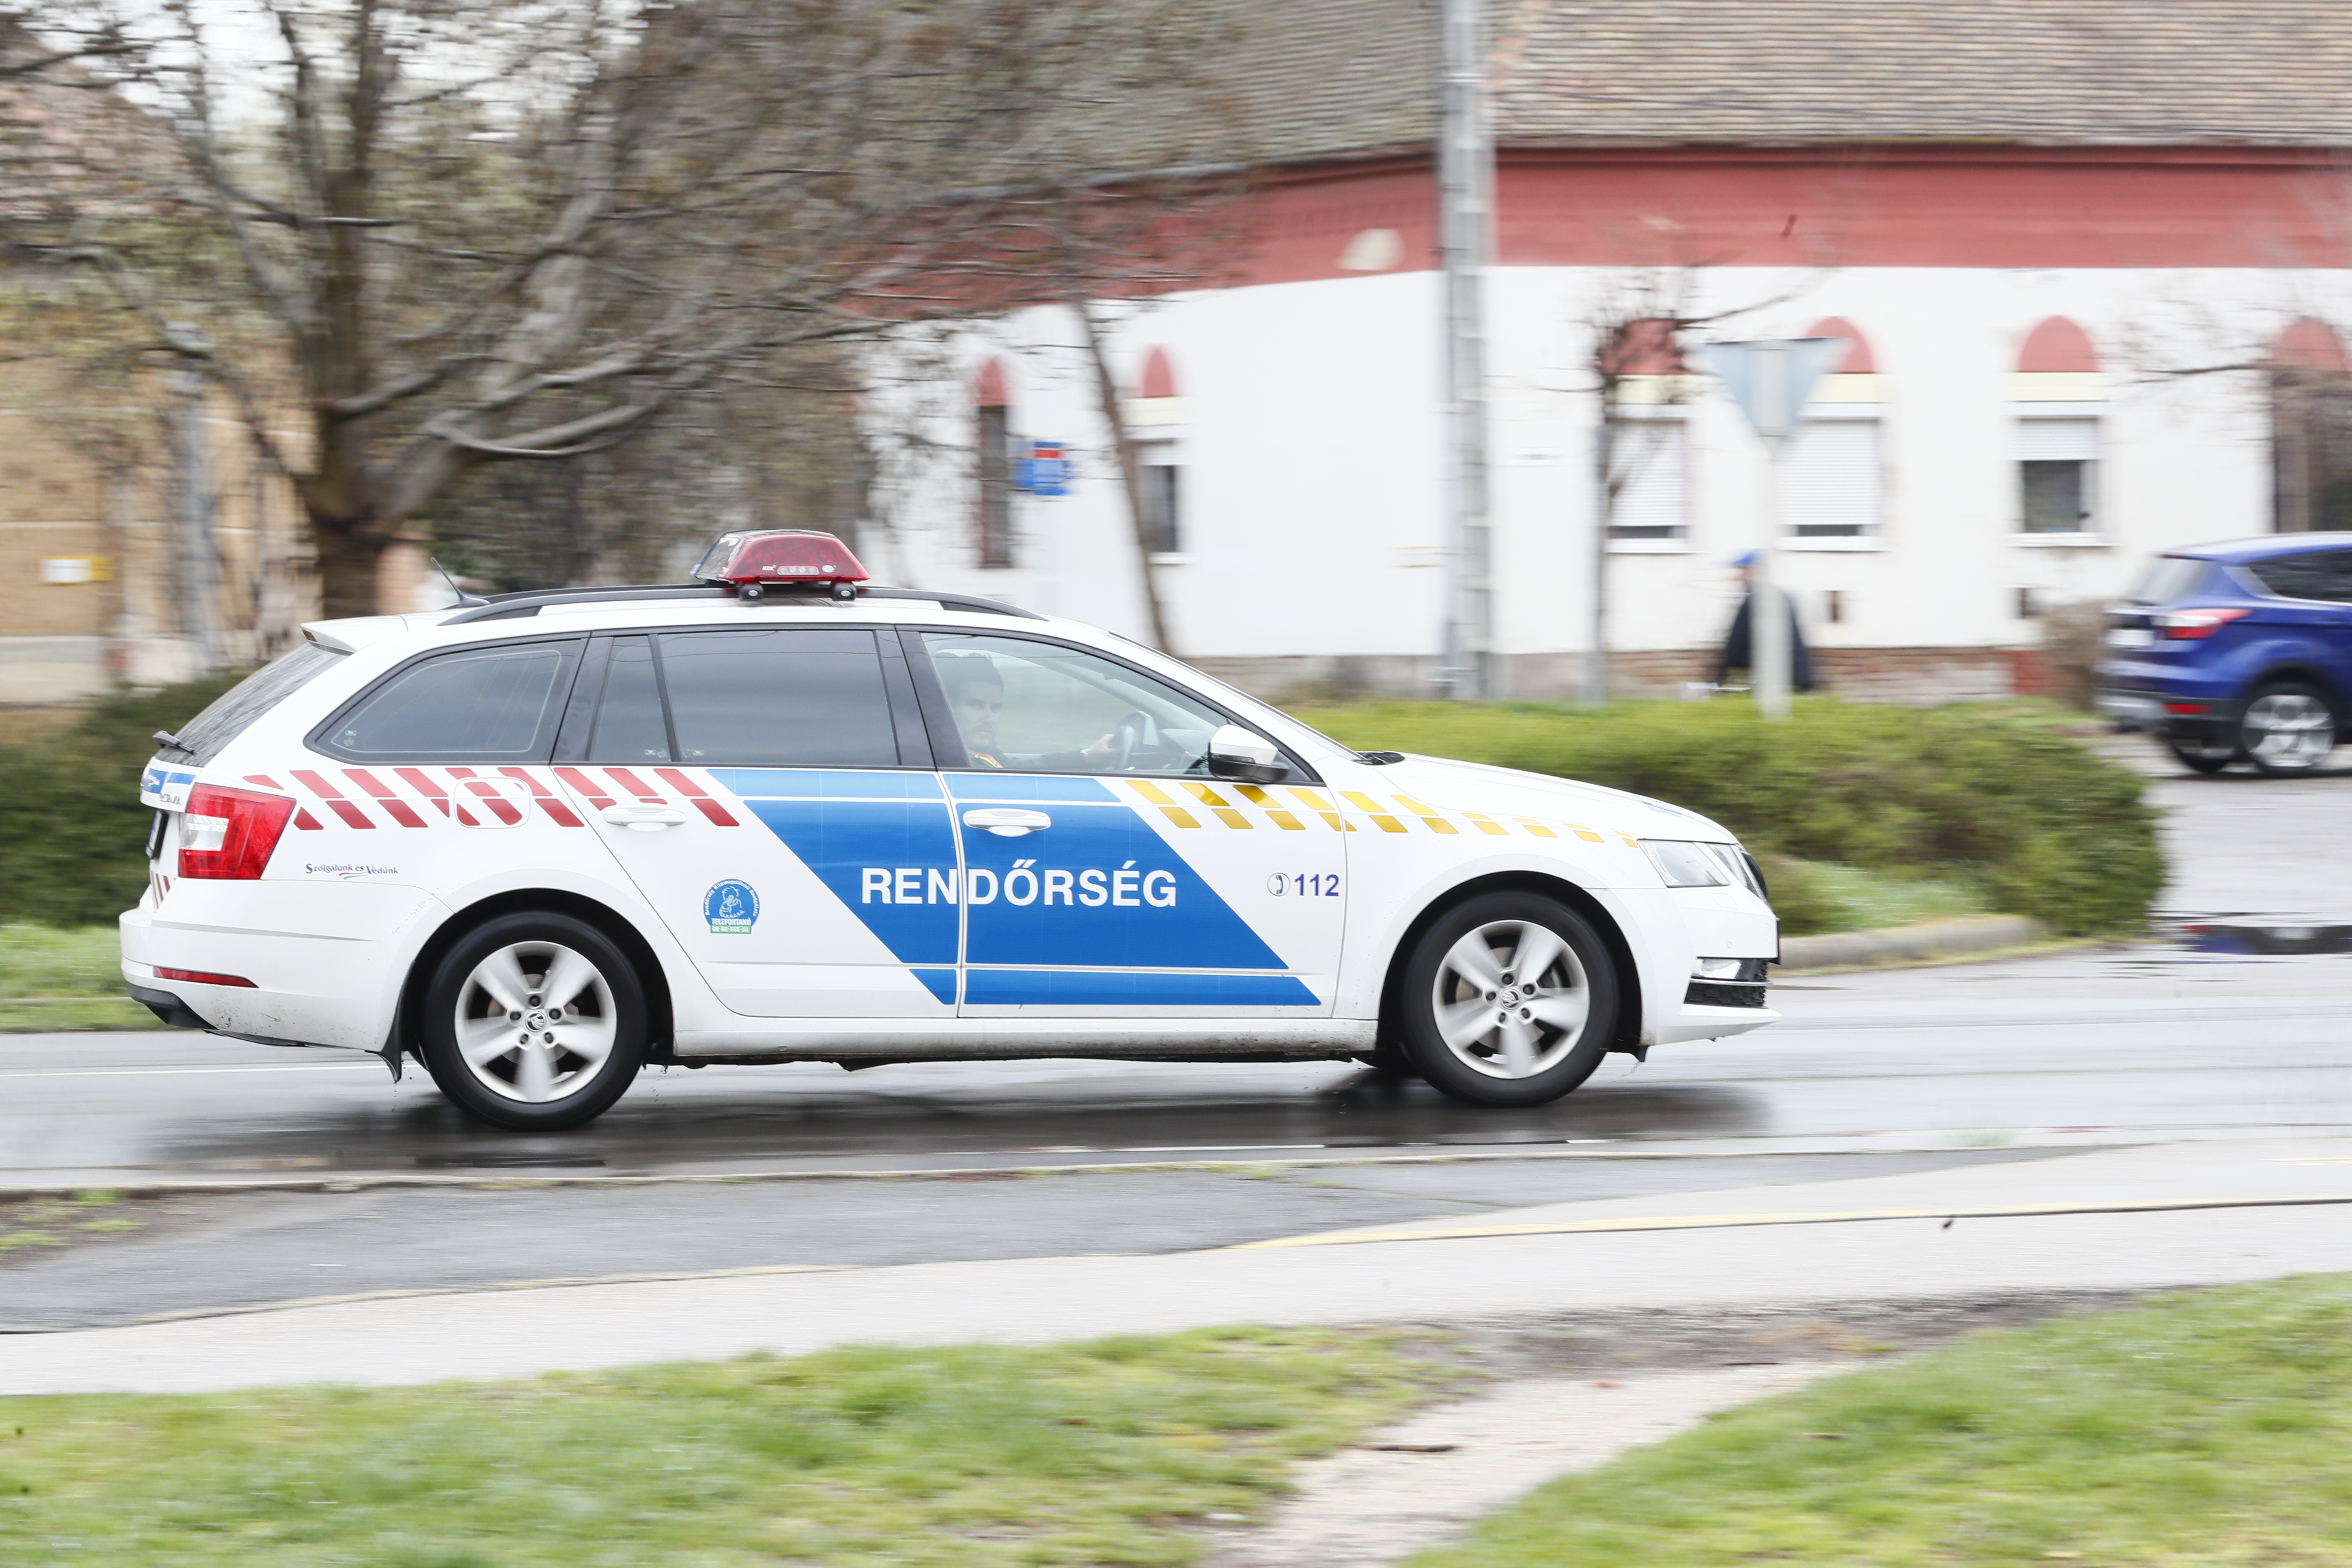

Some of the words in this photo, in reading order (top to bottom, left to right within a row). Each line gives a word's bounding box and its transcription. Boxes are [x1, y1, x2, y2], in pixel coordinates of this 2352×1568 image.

[305, 864, 353, 874] Szolgálunk
[366, 865, 399, 874] Védünk
[862, 859, 1177, 907] RENDŐRSÉG
[1294, 873, 1340, 897] 112
[711, 917, 752, 926] TELEFONTANÚ
